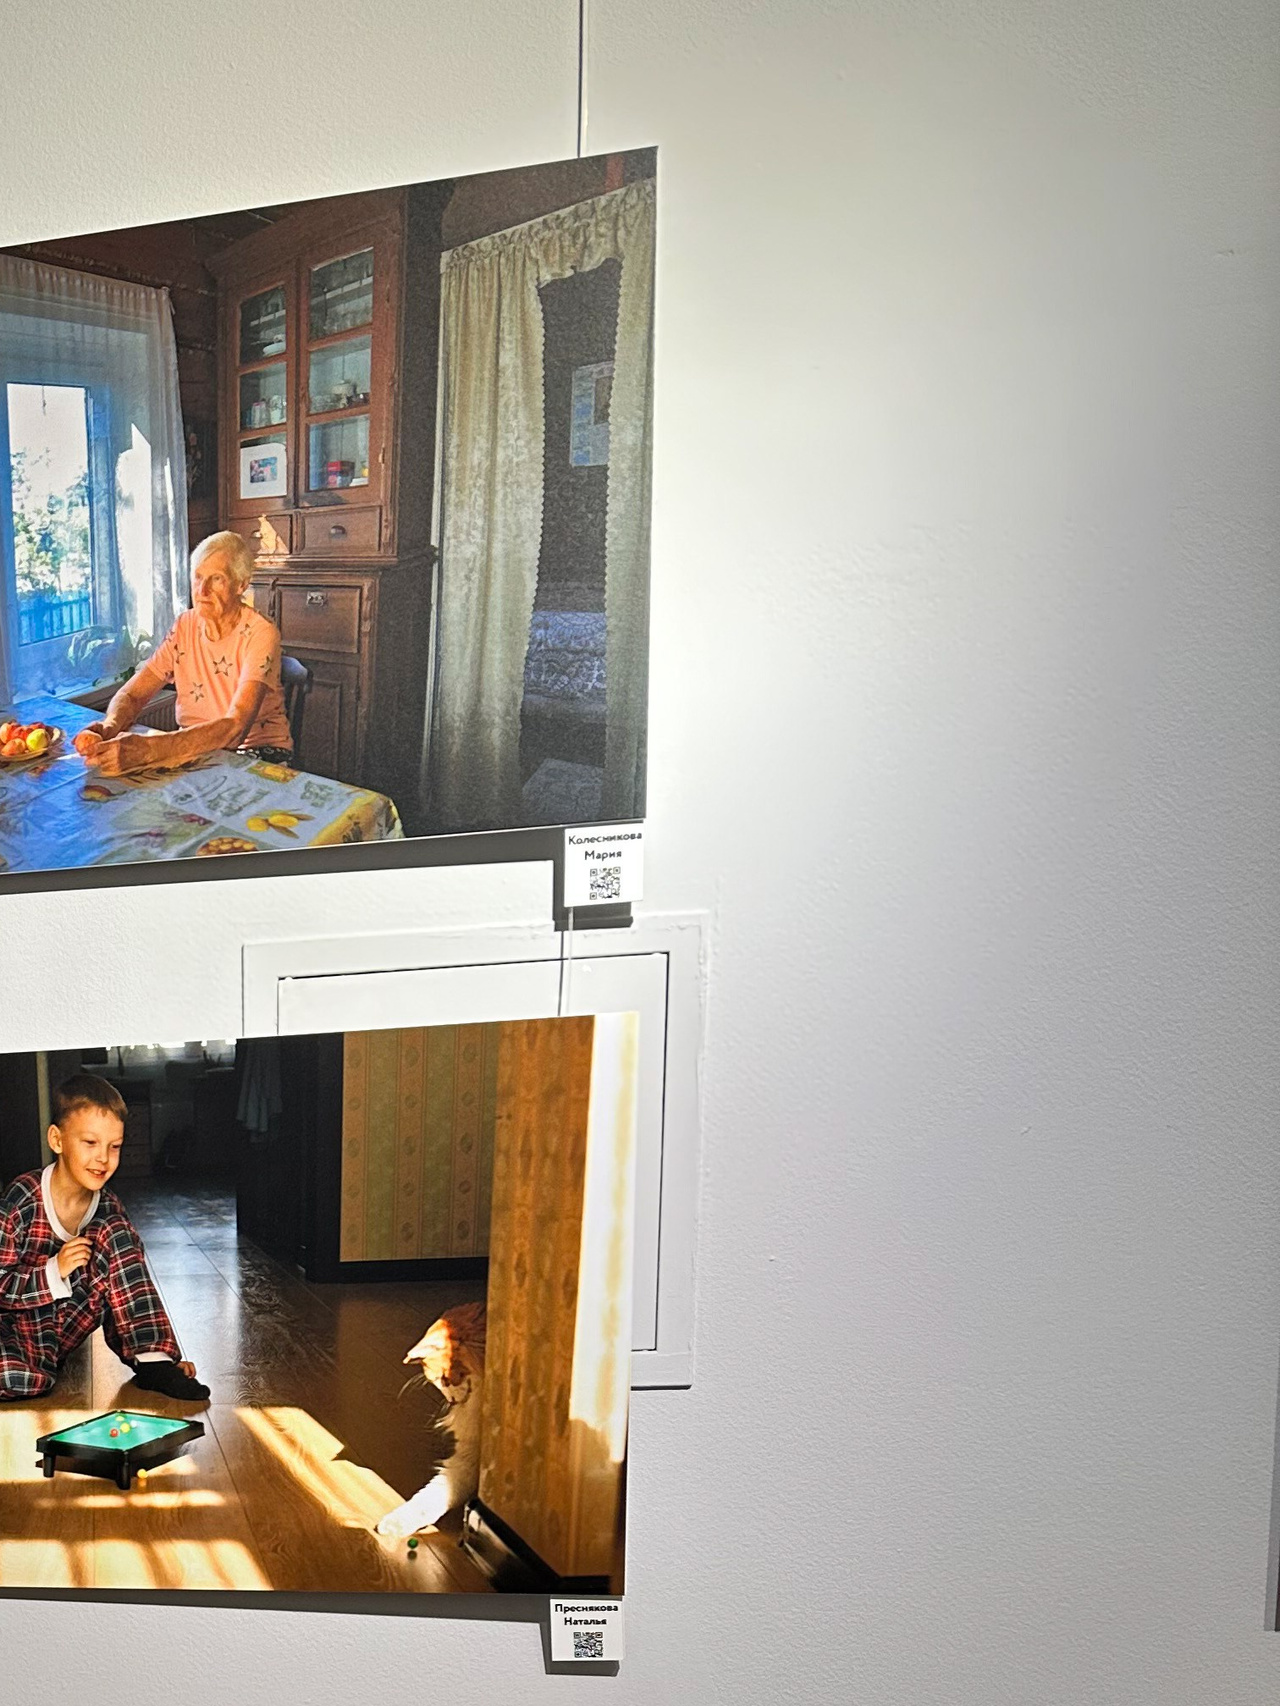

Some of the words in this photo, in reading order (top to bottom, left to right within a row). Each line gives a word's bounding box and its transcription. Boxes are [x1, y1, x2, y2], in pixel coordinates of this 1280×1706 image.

[568, 832, 643, 845] Колесникова
[584, 850, 622, 862] Мария
[555, 1603, 619, 1614] Преснякова
[564, 1617, 607, 1626] Наталья
